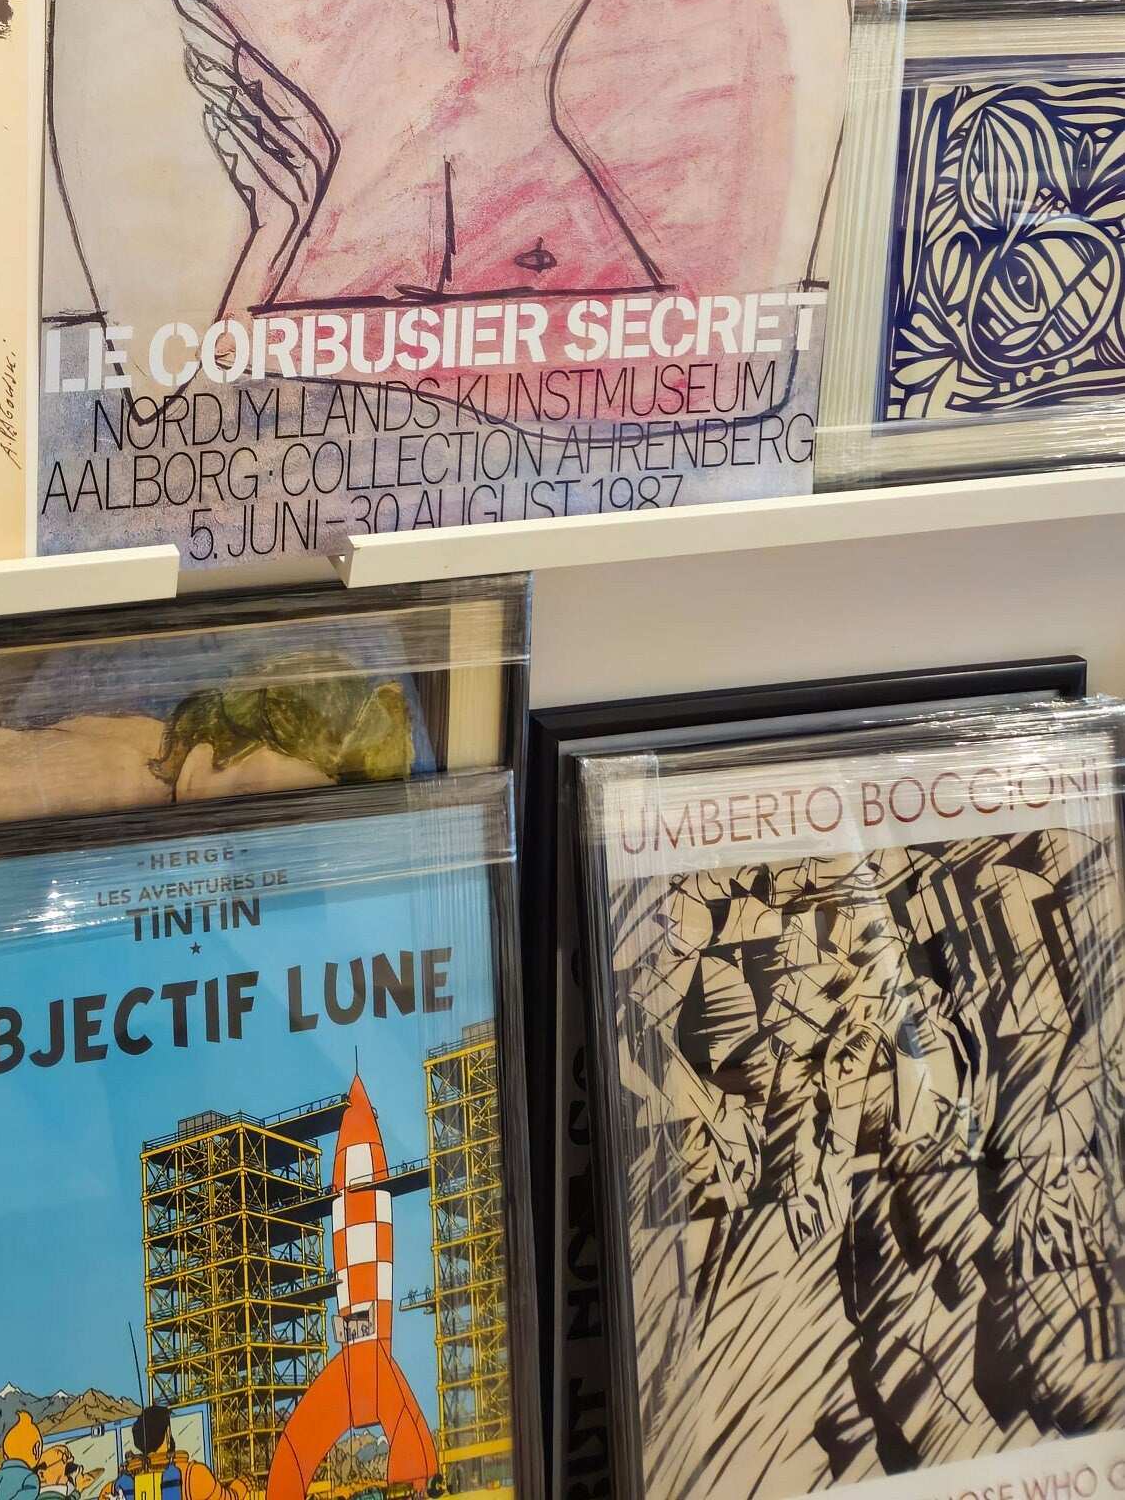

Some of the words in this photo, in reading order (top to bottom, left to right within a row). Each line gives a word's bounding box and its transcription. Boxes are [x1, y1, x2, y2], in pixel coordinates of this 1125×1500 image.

[43, 325, 133, 393] LE
[148, 302, 549, 388] CORBUSIER
[563, 292, 828, 363] SECRET
[92, 377, 441, 453] NORDJYLLANDS
[456, 360, 776, 428] KUNSTMUSEUM
[41, 446, 259, 516] AALBORG
[281, 425, 543, 497] COLLECTION
[557, 412, 815, 477] AHRENBERG
[189, 507, 219, 561] 5.
[227, 498, 319, 558] JUNI
[411, 477, 581, 530] AUGUST
[590, 474, 684, 514] 1987
[620, 786, 843, 855] UMBERTO
[861, 756, 1100, 828] BOCCIONI
[96, 888, 132, 908] LES
[139, 872, 255, 902] AVENTURES
[262, 868, 289, 887] DE
[126, 895, 261, 942] TINTIN
[287, 946, 454, 1034] LUNE
[1022, 1464, 1099, 1500] WHO
